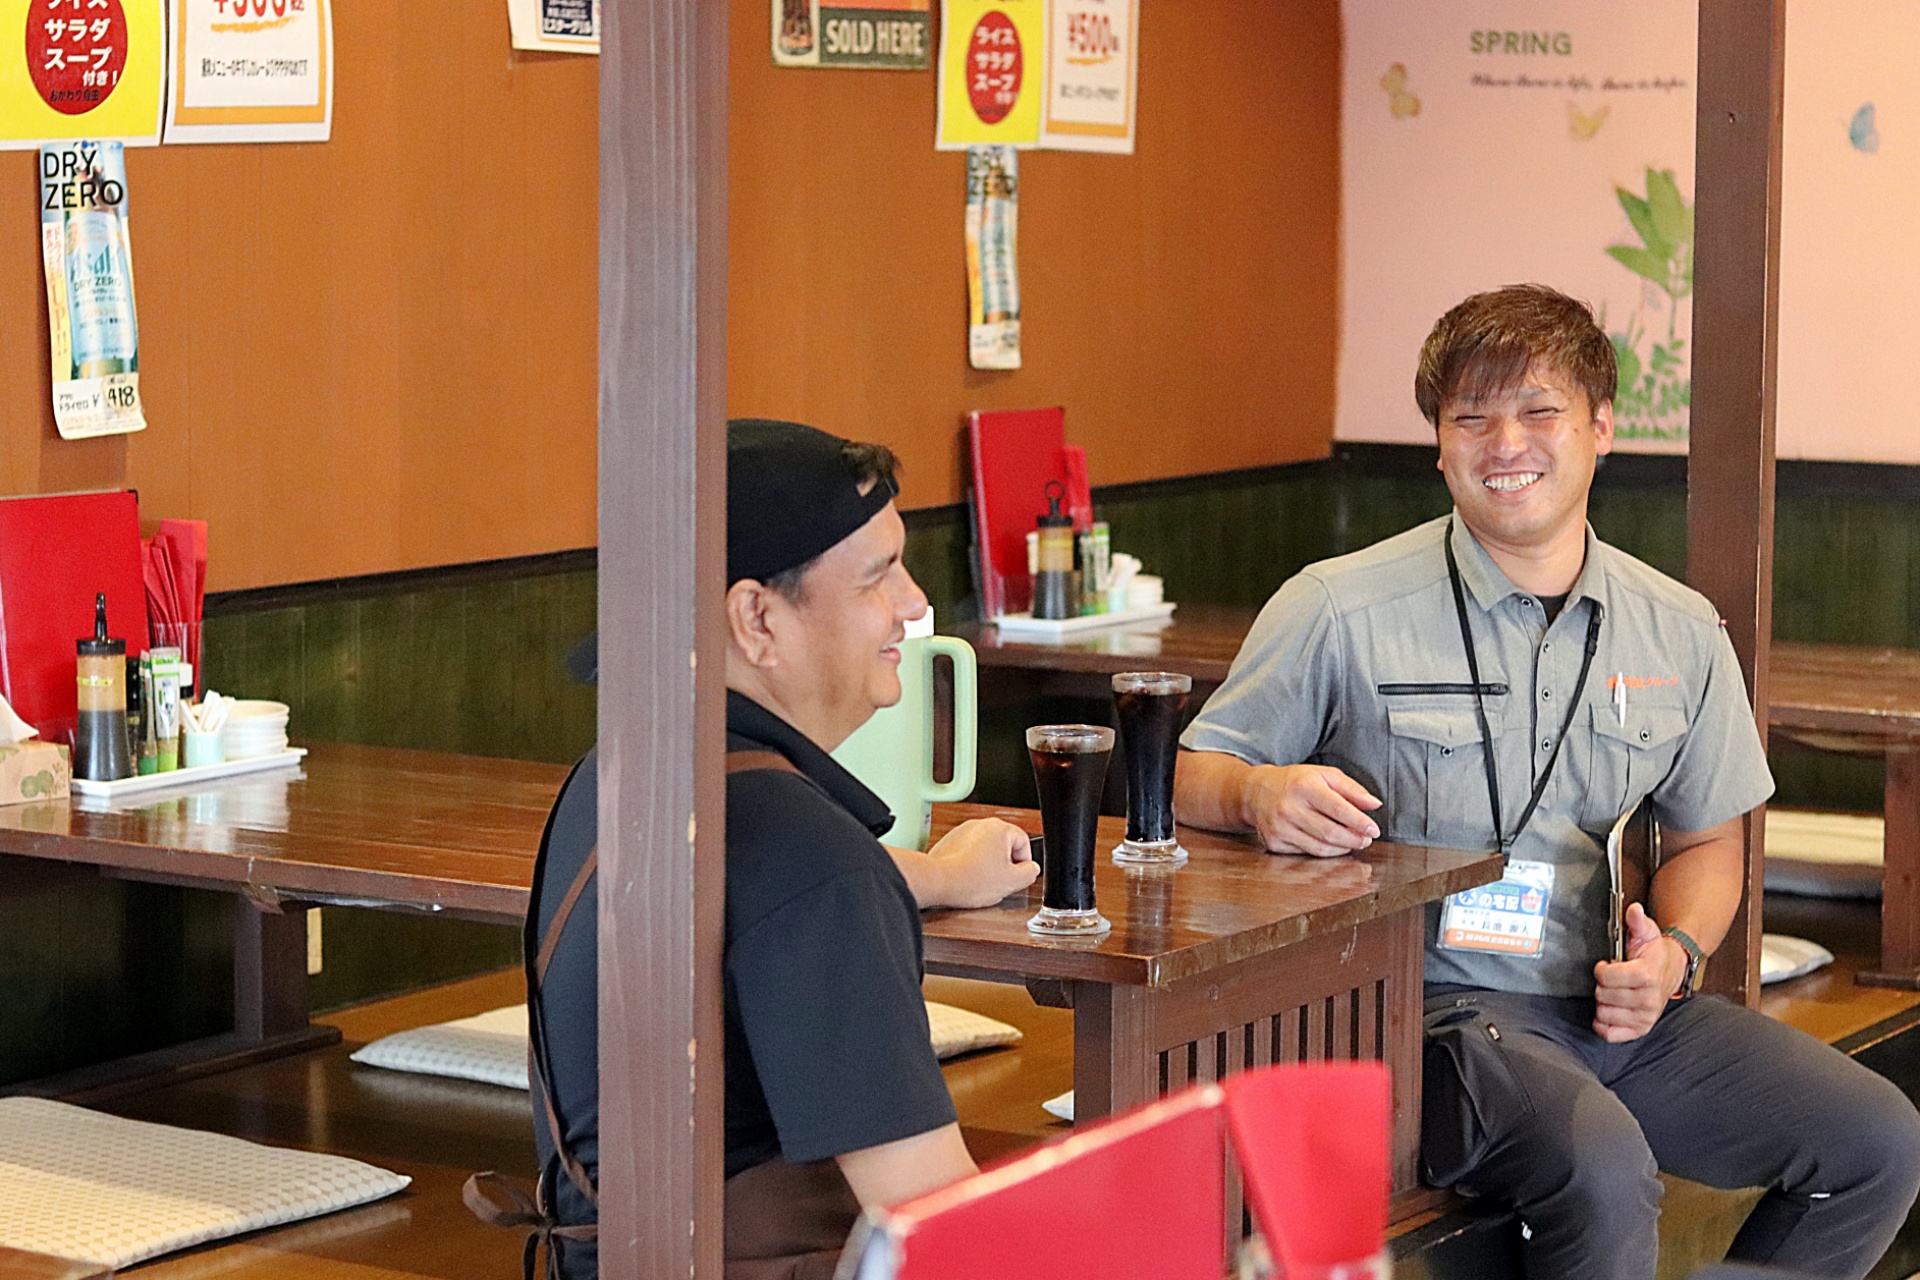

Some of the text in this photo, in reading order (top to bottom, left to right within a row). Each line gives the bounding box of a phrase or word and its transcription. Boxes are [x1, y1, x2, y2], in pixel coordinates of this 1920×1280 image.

[44, 17, 111, 42] サラダ
[826, 19, 925, 55] SOLD HERE
[975, 26, 1015, 45] ライス
[1470, 31, 1572, 55] SPRING
[44, 46, 113, 71] スープ
[974, 52, 1016, 71] サラダ
[973, 73, 1016, 91] スープ
[43, 150, 97, 178] DRY
[44, 179, 124, 210] ZERO
[108, 385, 135, 408] 418
